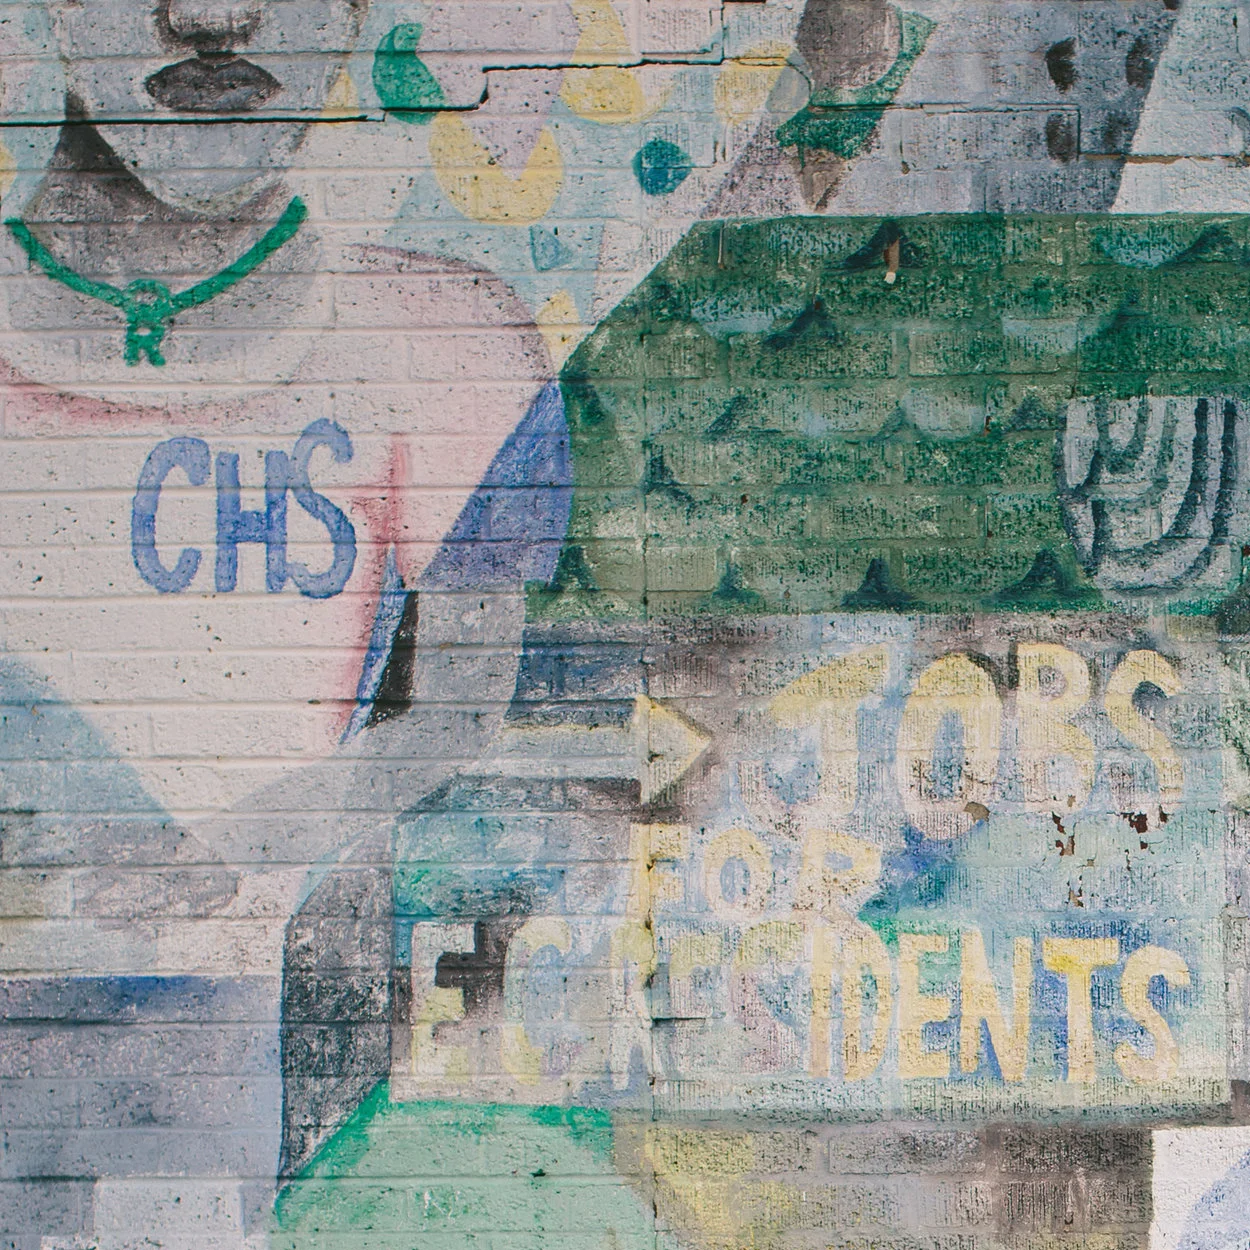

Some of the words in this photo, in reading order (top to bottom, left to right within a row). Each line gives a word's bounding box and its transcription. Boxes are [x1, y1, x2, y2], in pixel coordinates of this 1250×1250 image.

[131, 418, 357, 598] CHS
[738, 642, 1185, 840] JOBS
[631, 822, 883, 922] FOR
